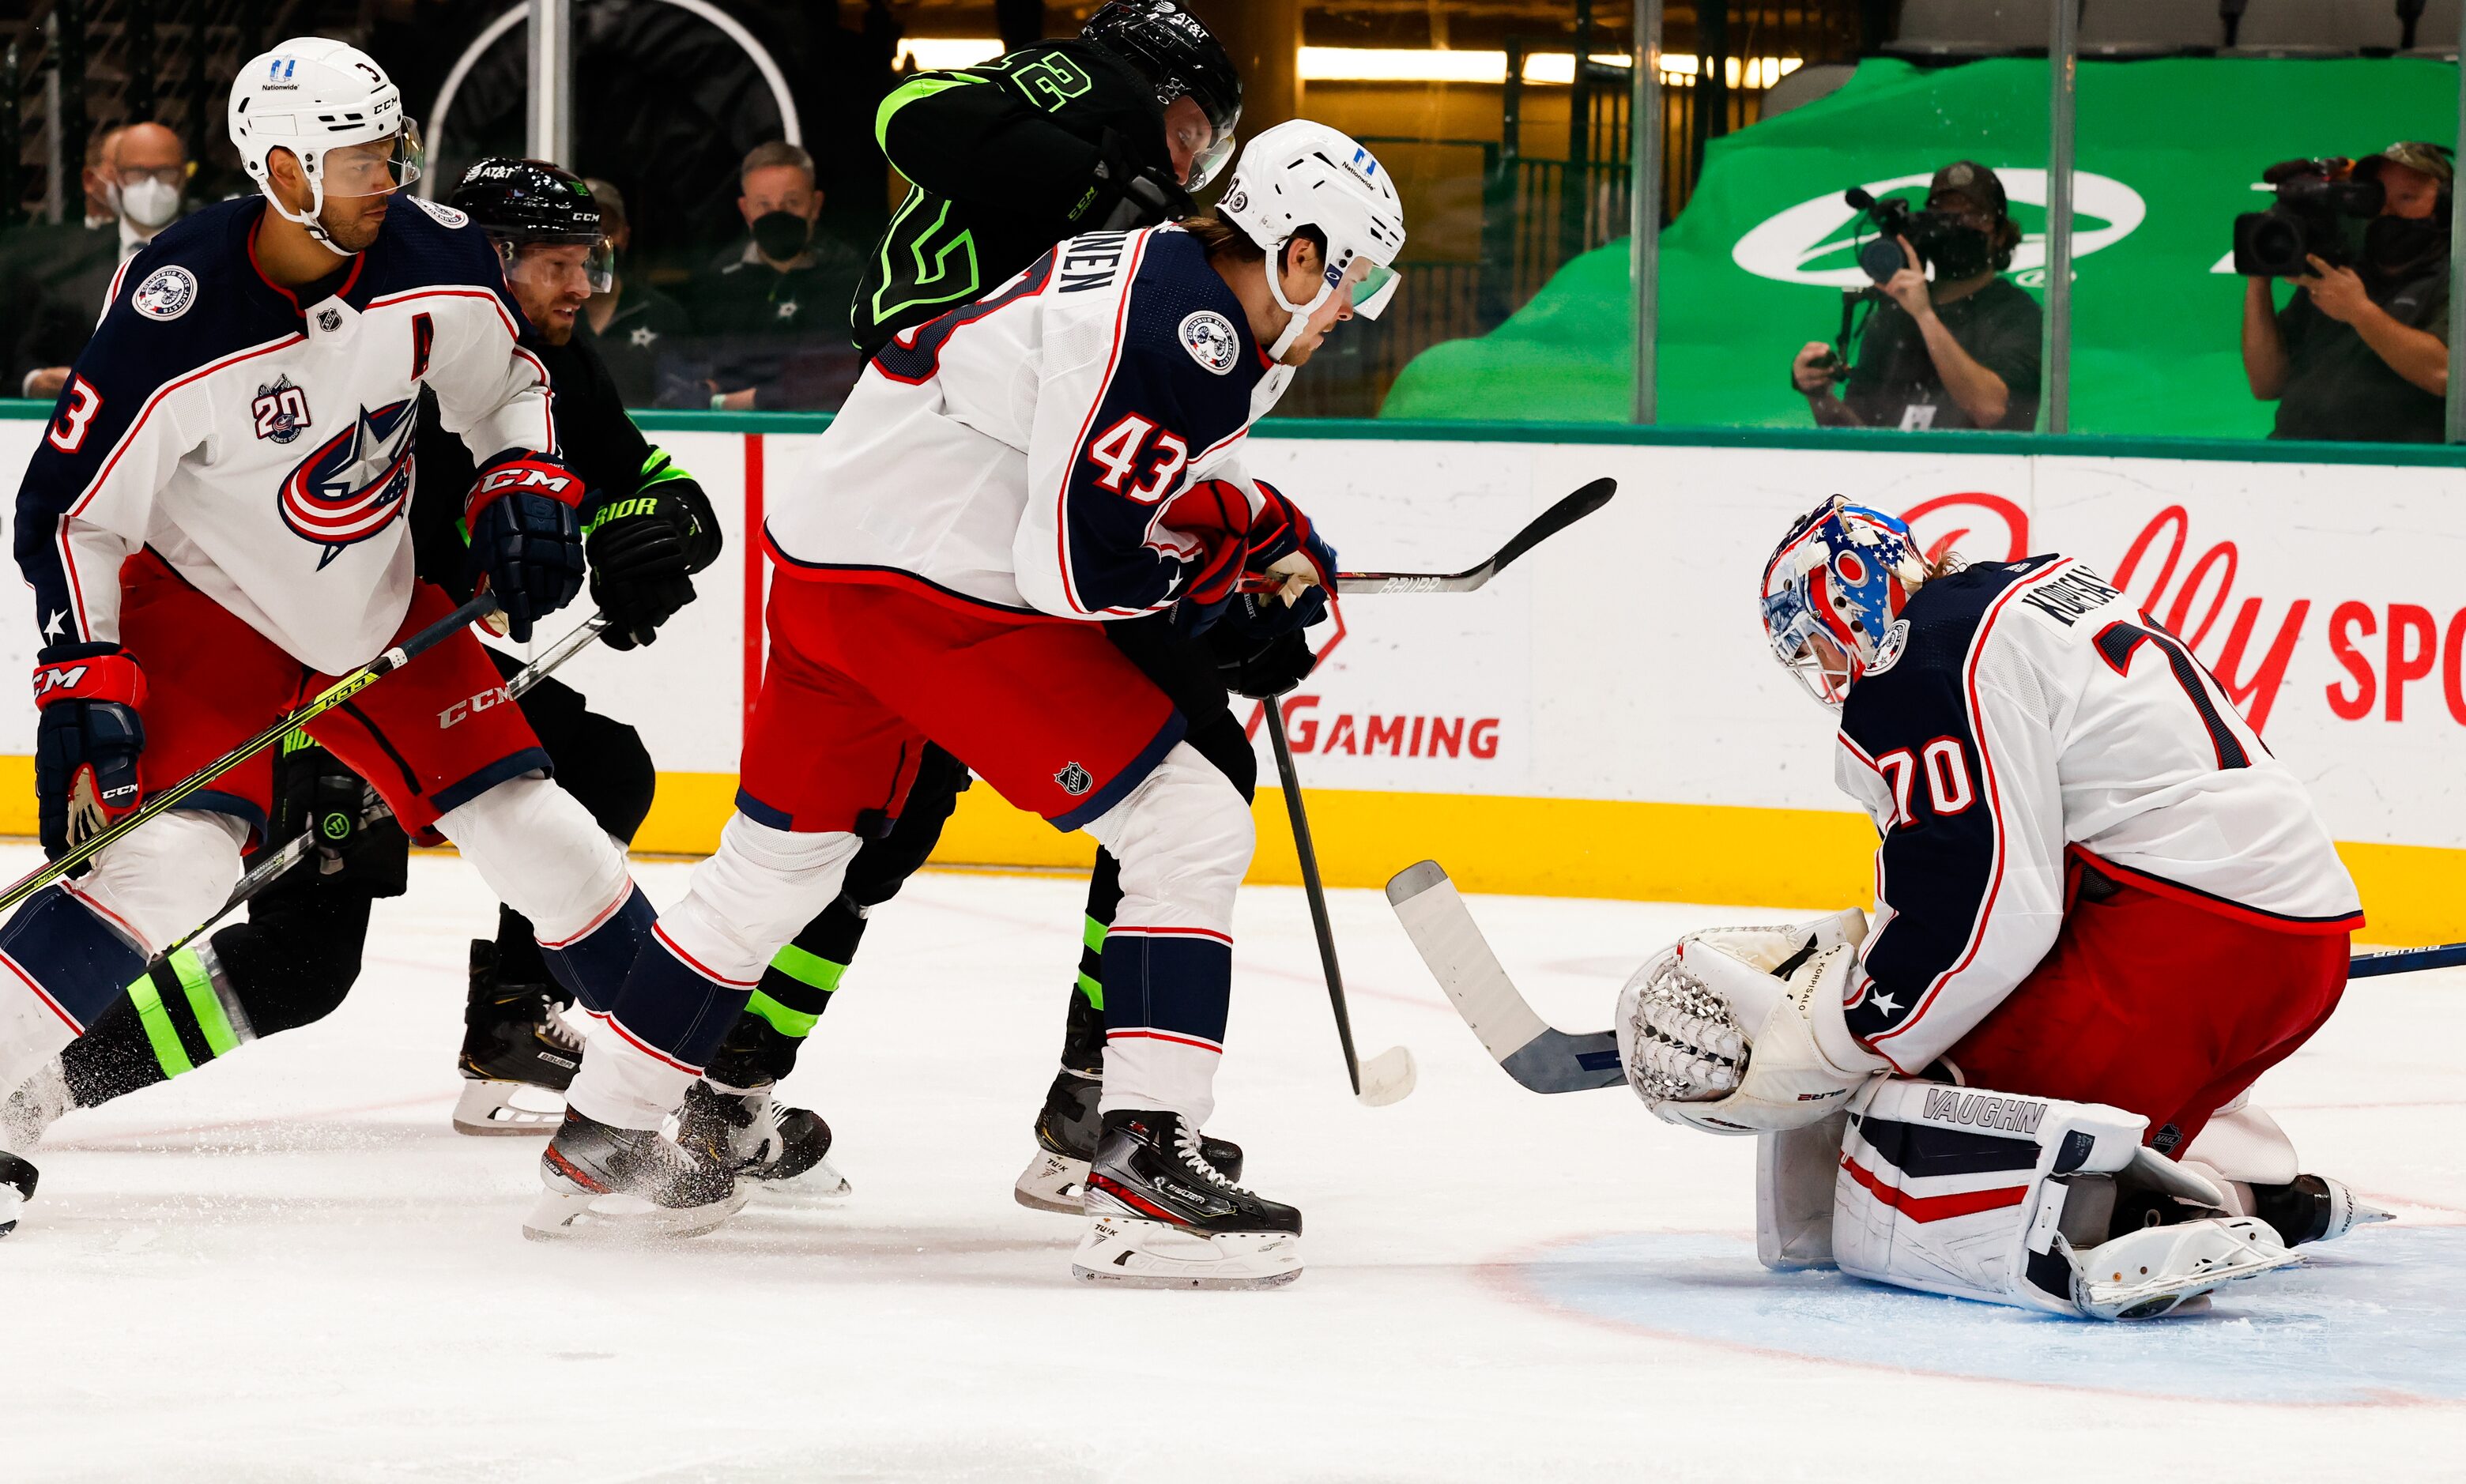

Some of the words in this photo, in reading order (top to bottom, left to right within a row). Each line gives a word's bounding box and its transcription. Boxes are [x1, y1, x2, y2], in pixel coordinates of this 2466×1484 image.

[1174, 13, 1209, 39] AT&T
[373, 96, 398, 115] CCM
[481, 166, 516, 179] AT&T
[1341, 160, 1375, 191] Nationwide
[572, 213, 601, 222] CCM
[142, 271, 177, 293] COLUMBUS
[177, 273, 190, 288] BLUE
[162, 289, 190, 314] JACKETS
[1187, 317, 1212, 341] COLUMBUS
[1214, 318, 1231, 337] BLUE
[47, 374, 104, 453] 3
[251, 386, 312, 439] 20
[270, 434, 288, 443] SINCE
[1088, 411, 1188, 506] 43
[325, 677, 366, 709] CCM
[436, 687, 514, 729] CCM
[1281, 695, 1500, 759] GAMING
[101, 783, 138, 800] CCM
[1874, 735, 1977, 829] 70
[1798, 962, 1826, 1011] KORPISALO
[1923, 1088, 2048, 1135] VAUGHN
